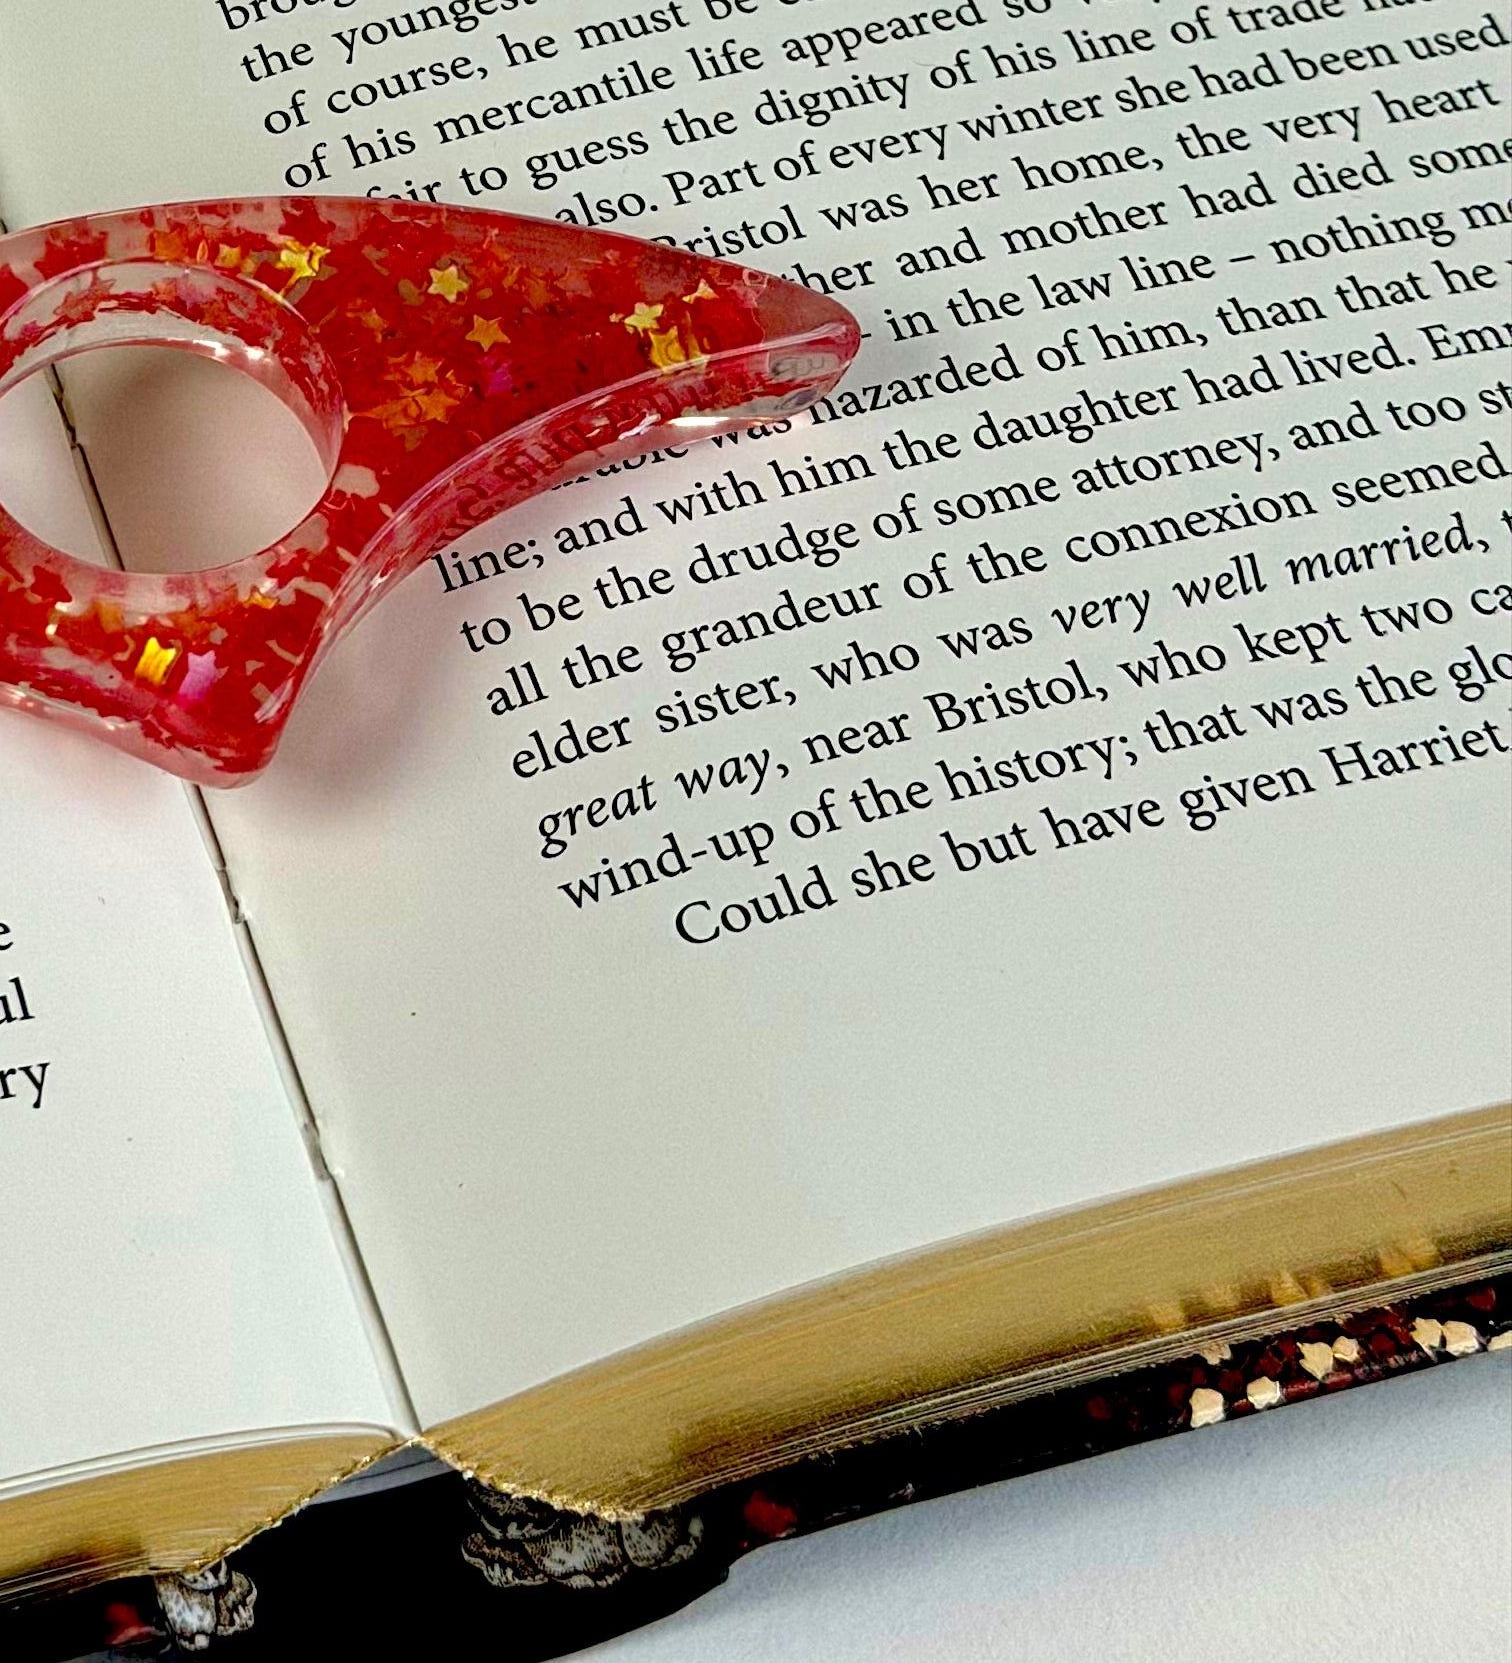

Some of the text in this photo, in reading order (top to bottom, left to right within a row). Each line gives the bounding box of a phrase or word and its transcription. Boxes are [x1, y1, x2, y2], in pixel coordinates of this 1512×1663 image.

[284, 141, 333, 189] of
[340, 127, 417, 170] his
[432, 59, 676, 145] mercantile
[684, 38, 765, 82] life
[538, 773, 658, 860] great
[673, 748, 790, 800] way,
[800, 713, 913, 765] near
[922, 658, 1109, 734] Bristol,
[1115, 639, 1227, 689] who
[1231, 611, 1353, 665] kept
[1359, 597, 1454, 638] two
[675, 719, 1510, 944] Could she but have given Harriet
